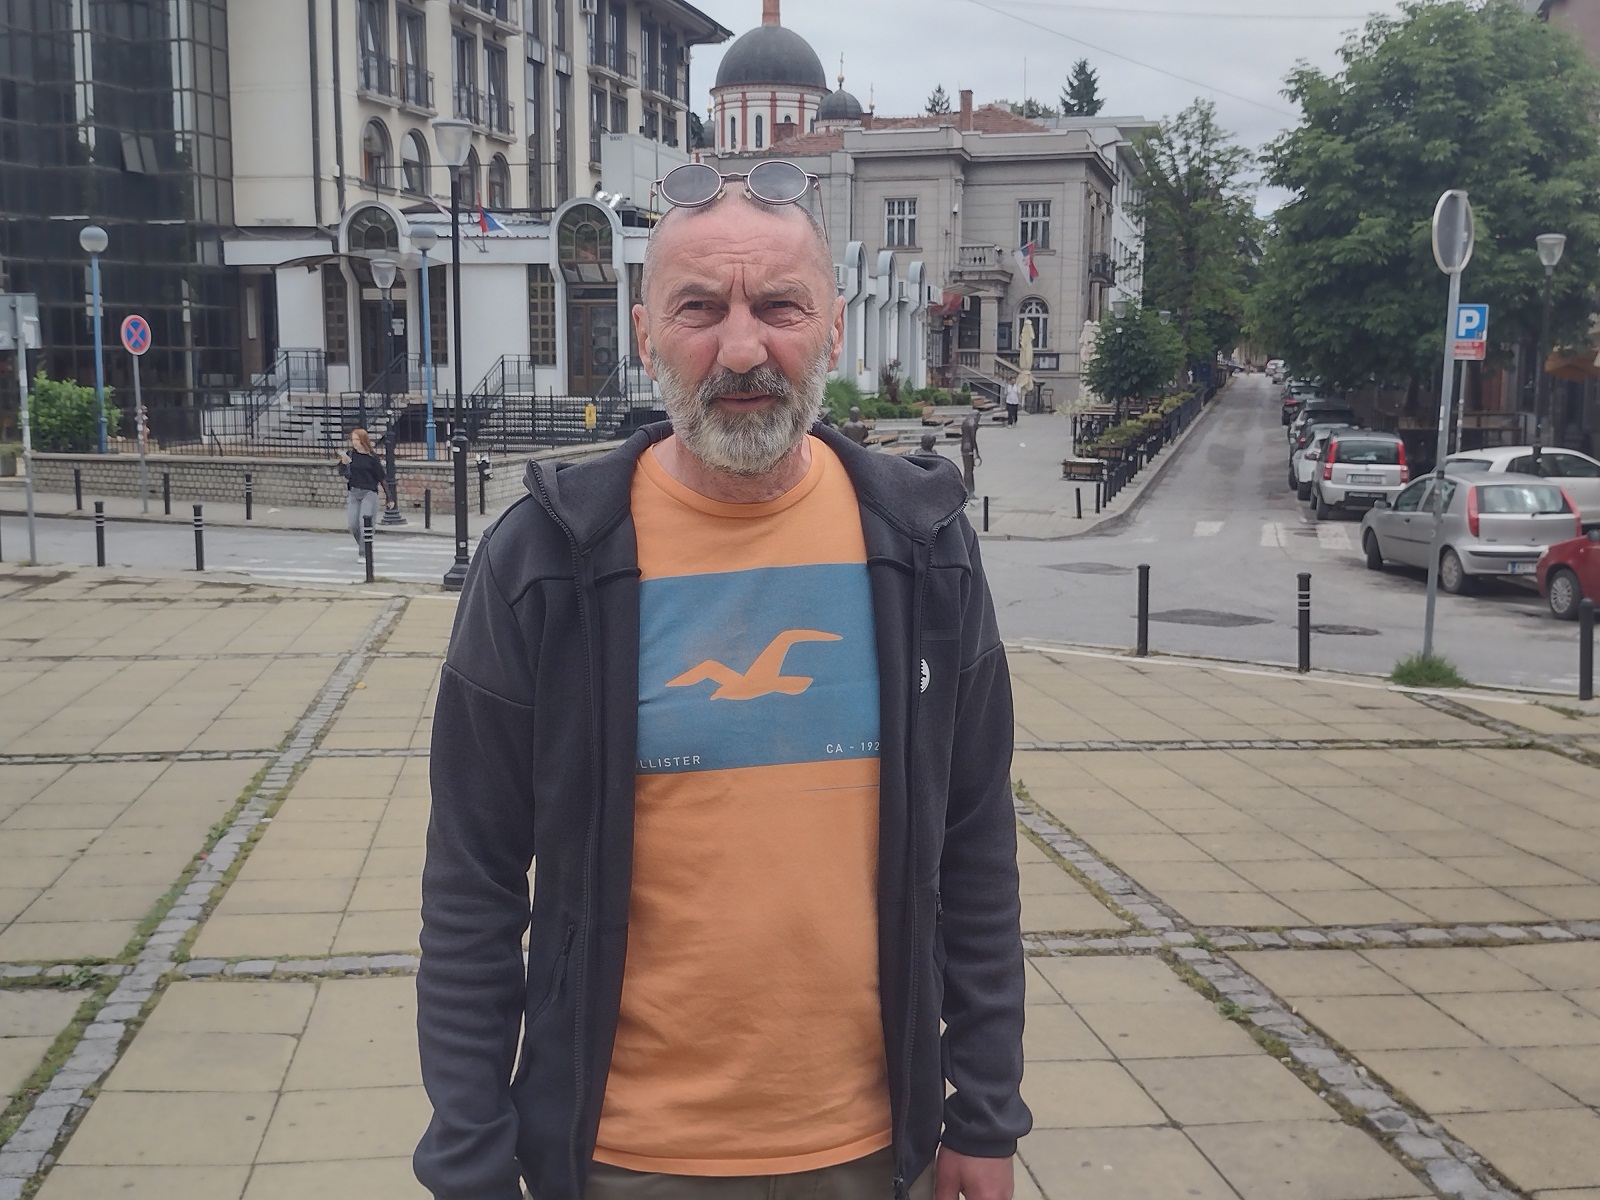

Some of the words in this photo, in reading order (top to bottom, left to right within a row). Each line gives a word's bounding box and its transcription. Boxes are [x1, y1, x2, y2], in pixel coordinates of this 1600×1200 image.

[1458, 309, 1480, 337] P
[826, 743, 843, 754] CA
[861, 741, 880, 751] 192
[636, 755, 700, 769] LLISTER
